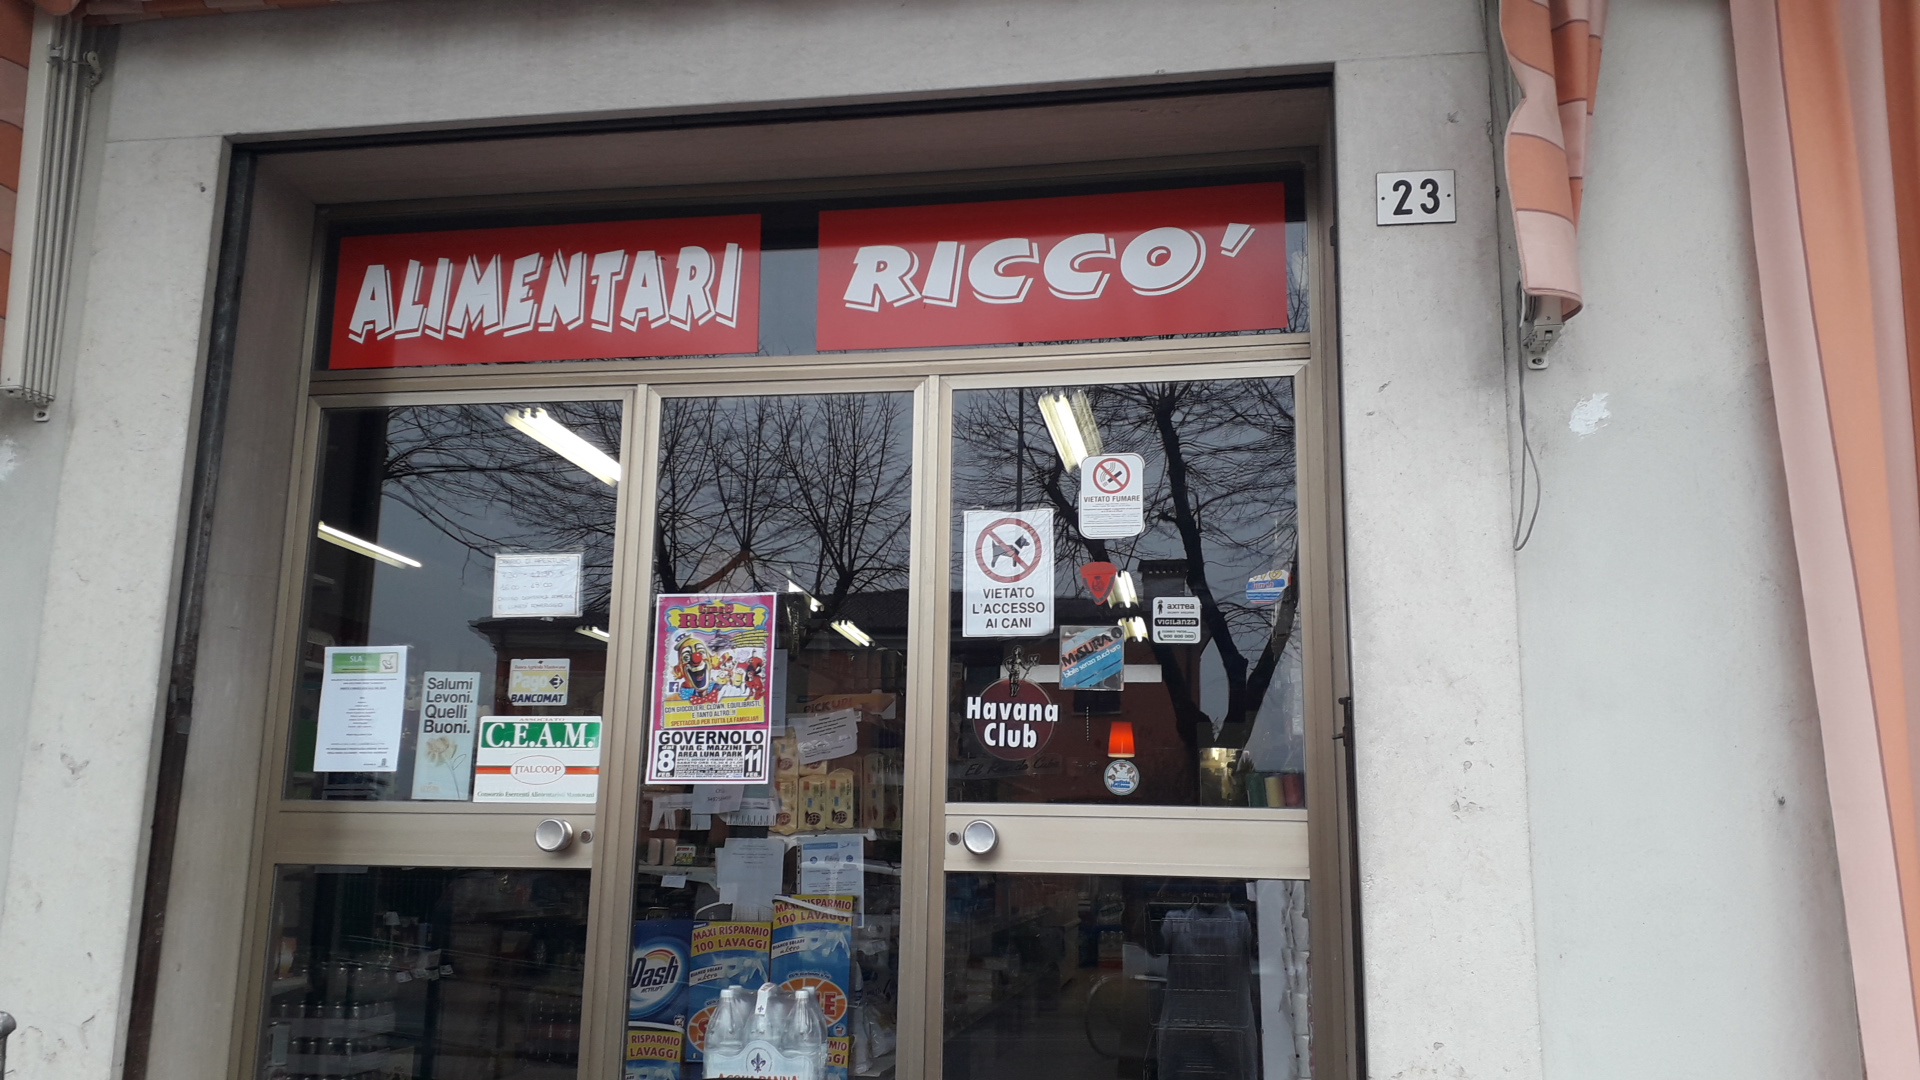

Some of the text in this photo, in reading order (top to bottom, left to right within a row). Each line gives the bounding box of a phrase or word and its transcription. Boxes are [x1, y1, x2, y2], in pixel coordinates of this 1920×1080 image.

[1392, 178, 1440, 216] 23
[843, 222, 1256, 313] RICCO'
[348, 242, 743, 344] ALIMENTARI
[1083, 494, 1141, 503] VIETATO FUMARE
[983, 586, 1035, 599] VIETATO
[972, 602, 1046, 615] L'ACCESSO
[678, 612, 756, 629] ROSSI
[985, 617, 1032, 629] AI CANI
[427, 677, 474, 690] Salumi
[425, 690, 473, 703] Levoni.
[511, 693, 565, 703] BANCOMAT
[424, 703, 468, 719] Quelli
[664, 706, 676, 714] CON
[696, 710, 713, 719] TANTO
[966, 696, 1059, 722] Havana
[422, 719, 471, 734] Buoni.
[670, 719, 700, 727] SPETTACOLO
[700, 718, 711, 726] PER
[711, 717, 726, 725] TUTTA
[726, 716, 734, 724] LA
[485, 722, 594, 748] C.E.A.M.
[658, 730, 765, 745] GOVERNOLO
[983, 722, 1037, 749] Club
[657, 749, 675, 772] 8
[721, 750, 743, 758] PARK
[745, 749, 762, 772] 11
[776, 913, 796, 926] 100
[693, 925, 770, 941] MAXI RISPARMIO
[694, 940, 714, 953] 100
[718, 937, 768, 950] LAVAGGI
[630, 955, 679, 989] Dash
[631, 1034, 680, 1046] RISPARMIO
[629, 1047, 678, 1059] LAVAGGI
